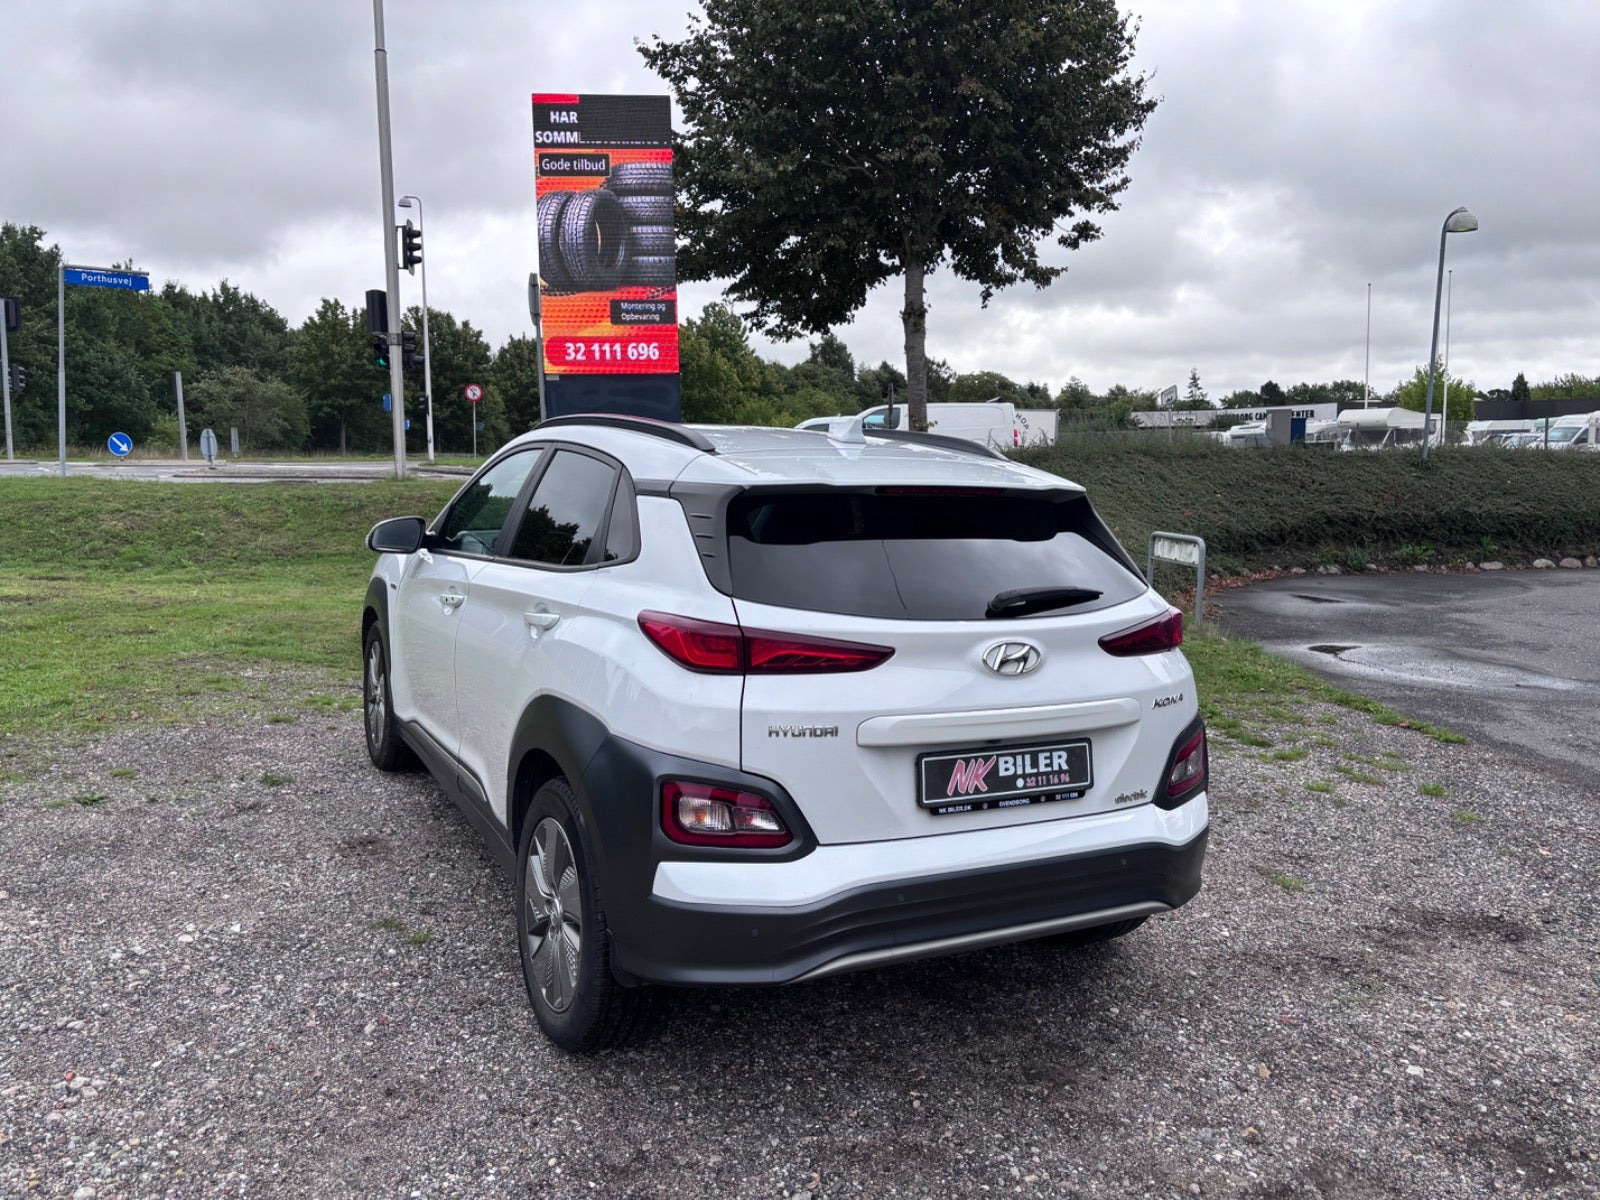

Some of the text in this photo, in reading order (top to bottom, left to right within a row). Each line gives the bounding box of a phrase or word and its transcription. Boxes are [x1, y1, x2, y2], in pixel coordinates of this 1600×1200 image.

[549, 111, 579, 123] HAR
[535, 131, 582, 144] SOMM
[541, 158, 606, 171] Gode tilbud
[81, 272, 132, 287] Porthusvej
[620, 302, 667, 312] Montering og
[620, 312, 661, 321] Opbevaring
[564, 342, 660, 361] 32 111 696
[1291, 409, 1315, 419] ENTER
[1152, 692, 1184, 710] KONA
[768, 725, 839, 738] HYUNDAI
[946, 750, 1070, 796] NK BILER
